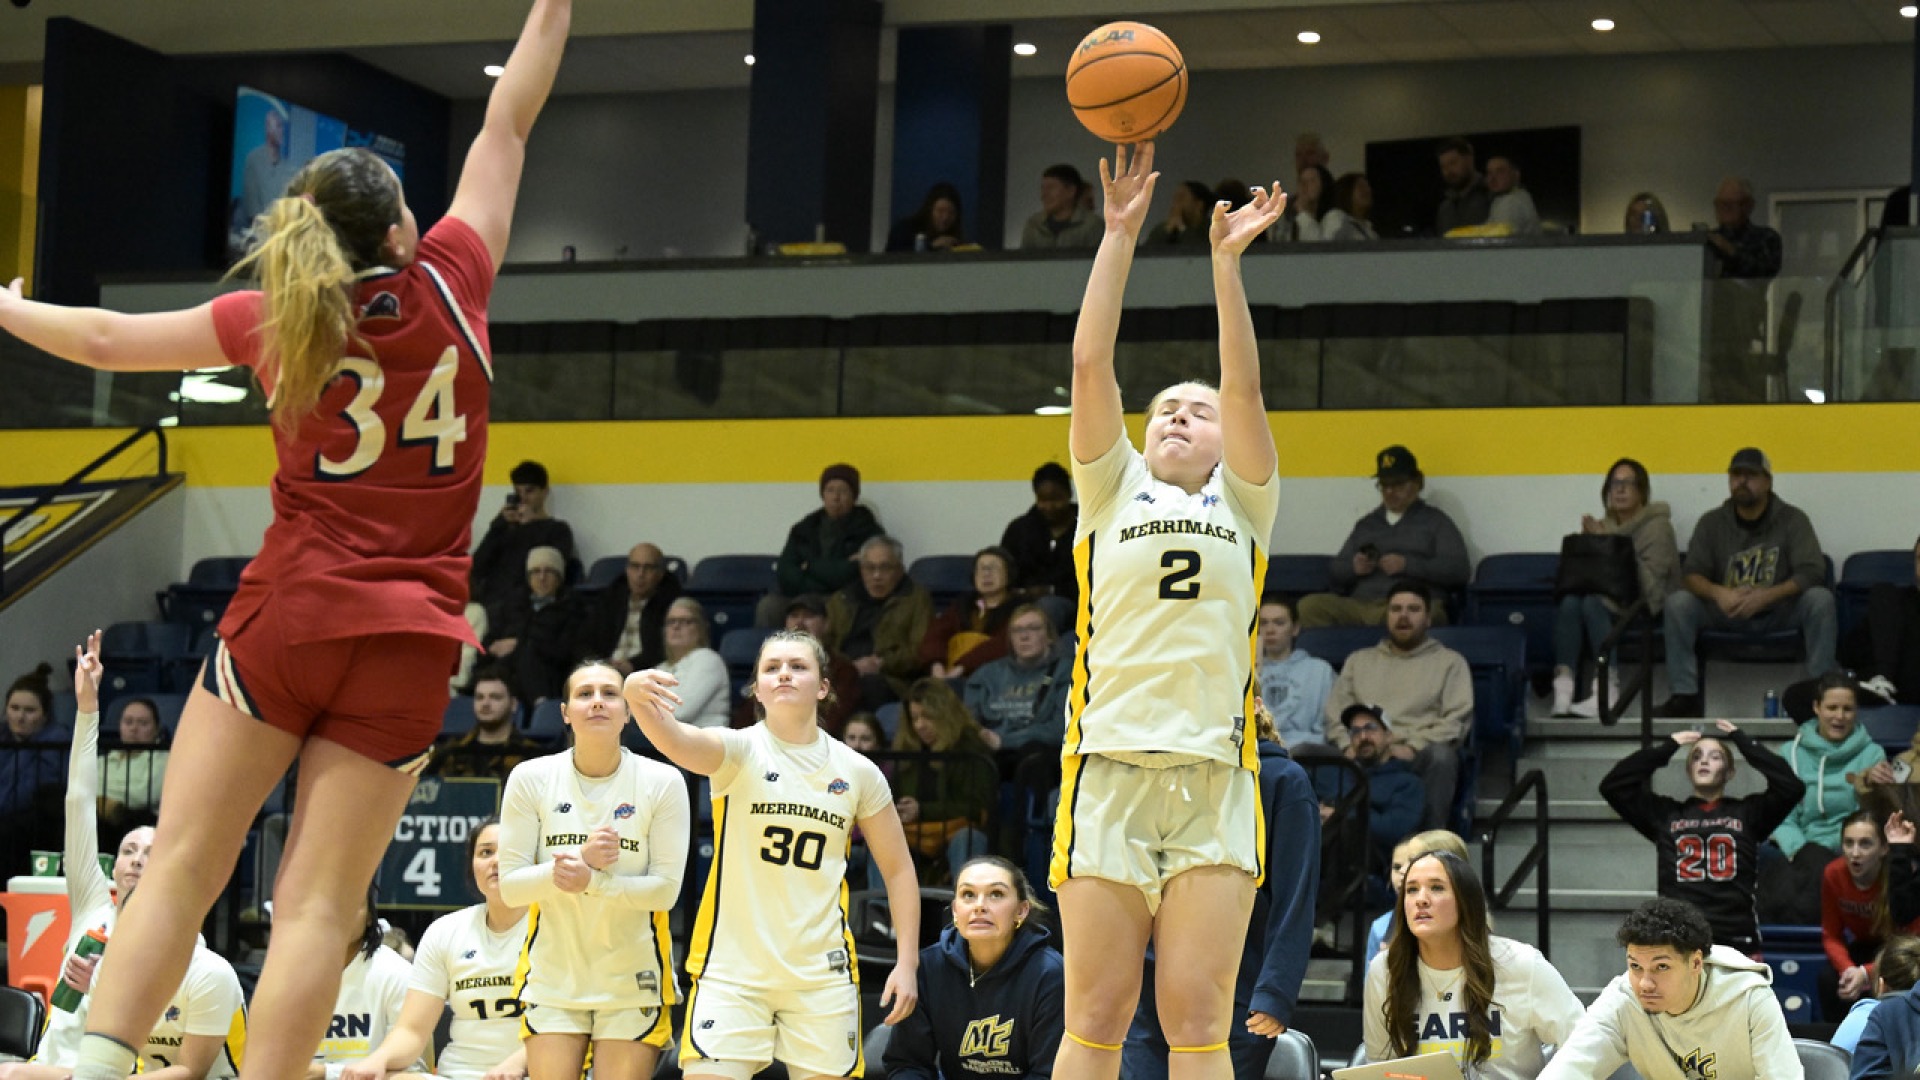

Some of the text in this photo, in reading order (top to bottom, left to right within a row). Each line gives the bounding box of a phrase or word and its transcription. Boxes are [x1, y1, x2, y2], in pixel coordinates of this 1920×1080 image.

[314, 344, 467, 481] 34
[1118, 519, 1238, 544] MERRIMACK
[1158, 549, 1202, 600] 2
[394, 815, 490, 843] CTIO
[750, 802, 846, 830] MERRIMACK
[545, 834, 640, 852] MERRCK
[760, 825, 828, 871] 30
[1675, 833, 1738, 882] 20
[402, 848, 442, 897] 4
[455, 975, 515, 992] MERRIM
[325, 1013, 370, 1038] RN
